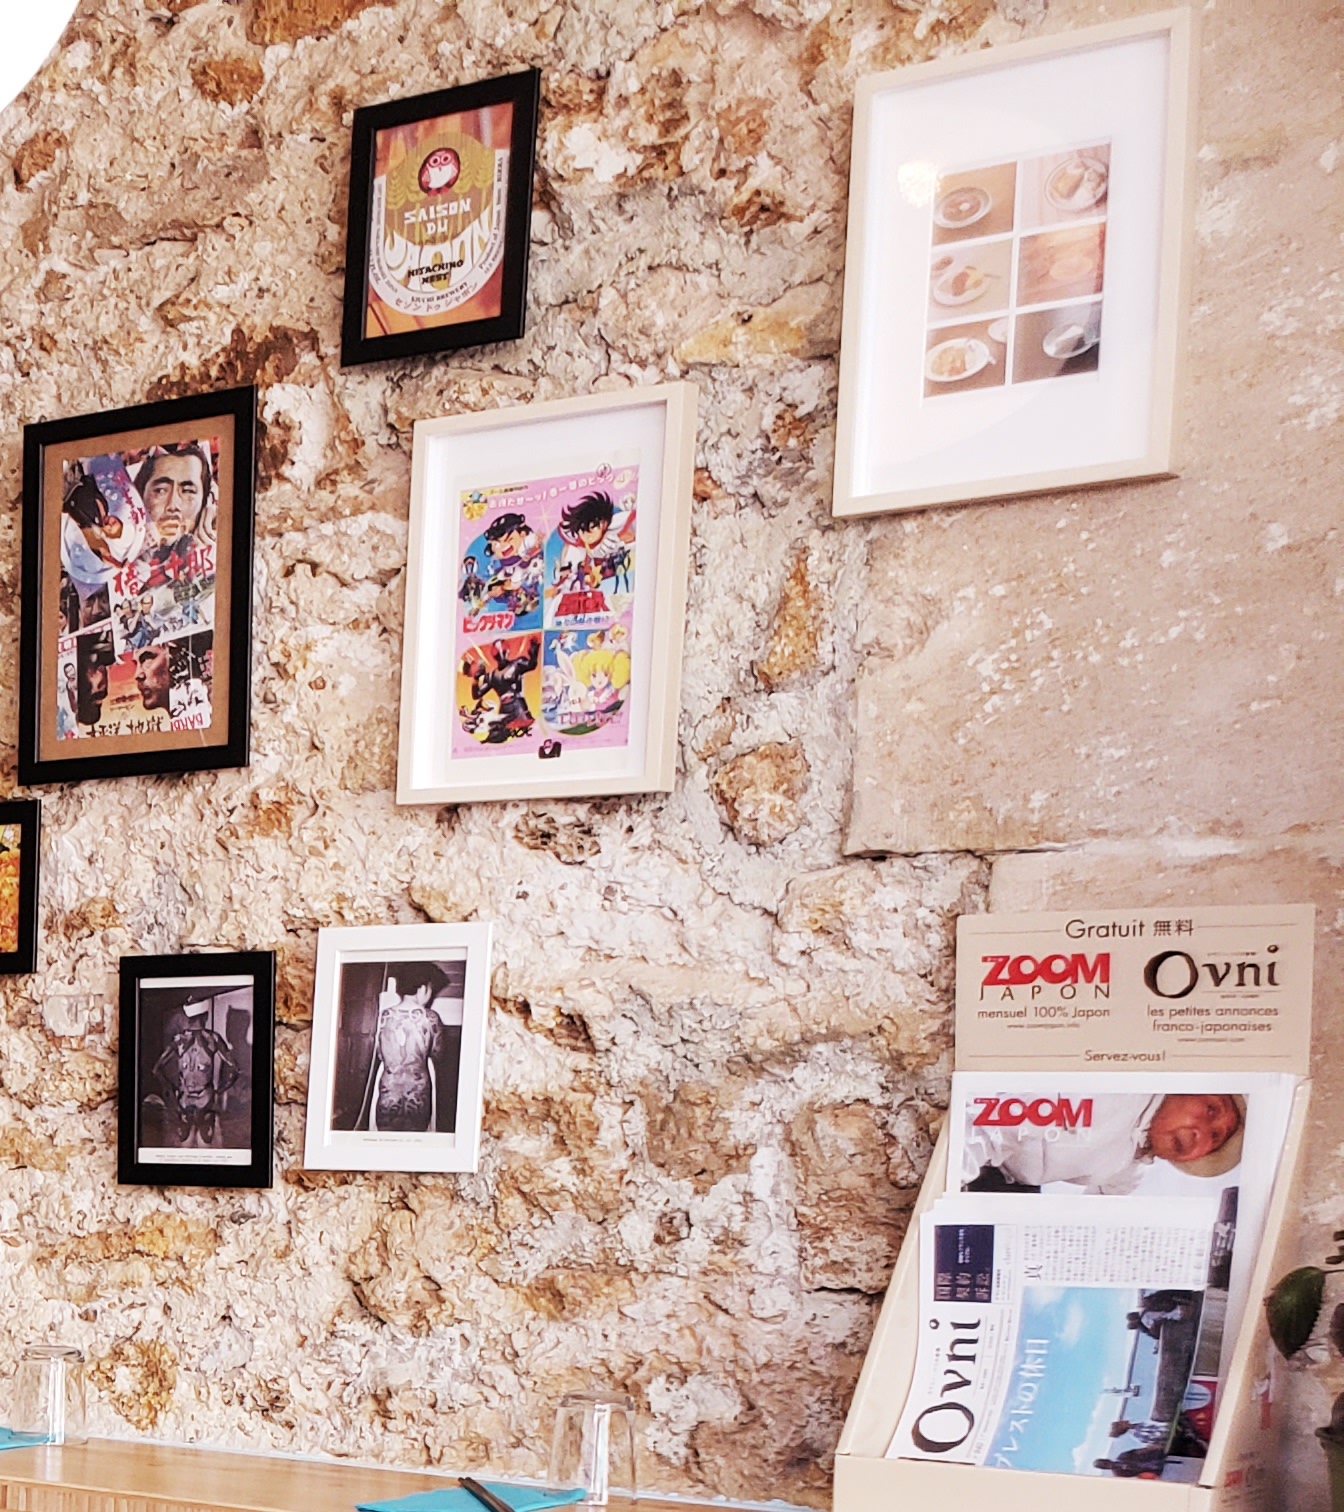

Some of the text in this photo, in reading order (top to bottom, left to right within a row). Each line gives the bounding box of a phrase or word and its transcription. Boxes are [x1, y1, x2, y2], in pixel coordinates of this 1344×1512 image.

[404, 198, 472, 224] SAISON
[427, 219, 449, 235] DU
[407, 259, 464, 278] HITACHINO
[421, 272, 449, 285] NEST
[1065, 919, 1194, 939] Gratuit 無料
[981, 952, 1111, 986] ZOOM
[1143, 944, 1281, 999] Ovni
[979, 984, 1110, 1001] JAPON
[977, 1006, 1110, 1020] mensuel 100% Japon
[1147, 1005, 1279, 1019] les petites annonces
[1152, 1020, 1272, 1034] franco-japonaises
[1084, 1049, 1166, 1062] Servez-vous!
[973, 1098, 1093, 1127] ZOOM
[911, 1317, 981, 1453] Ovni
